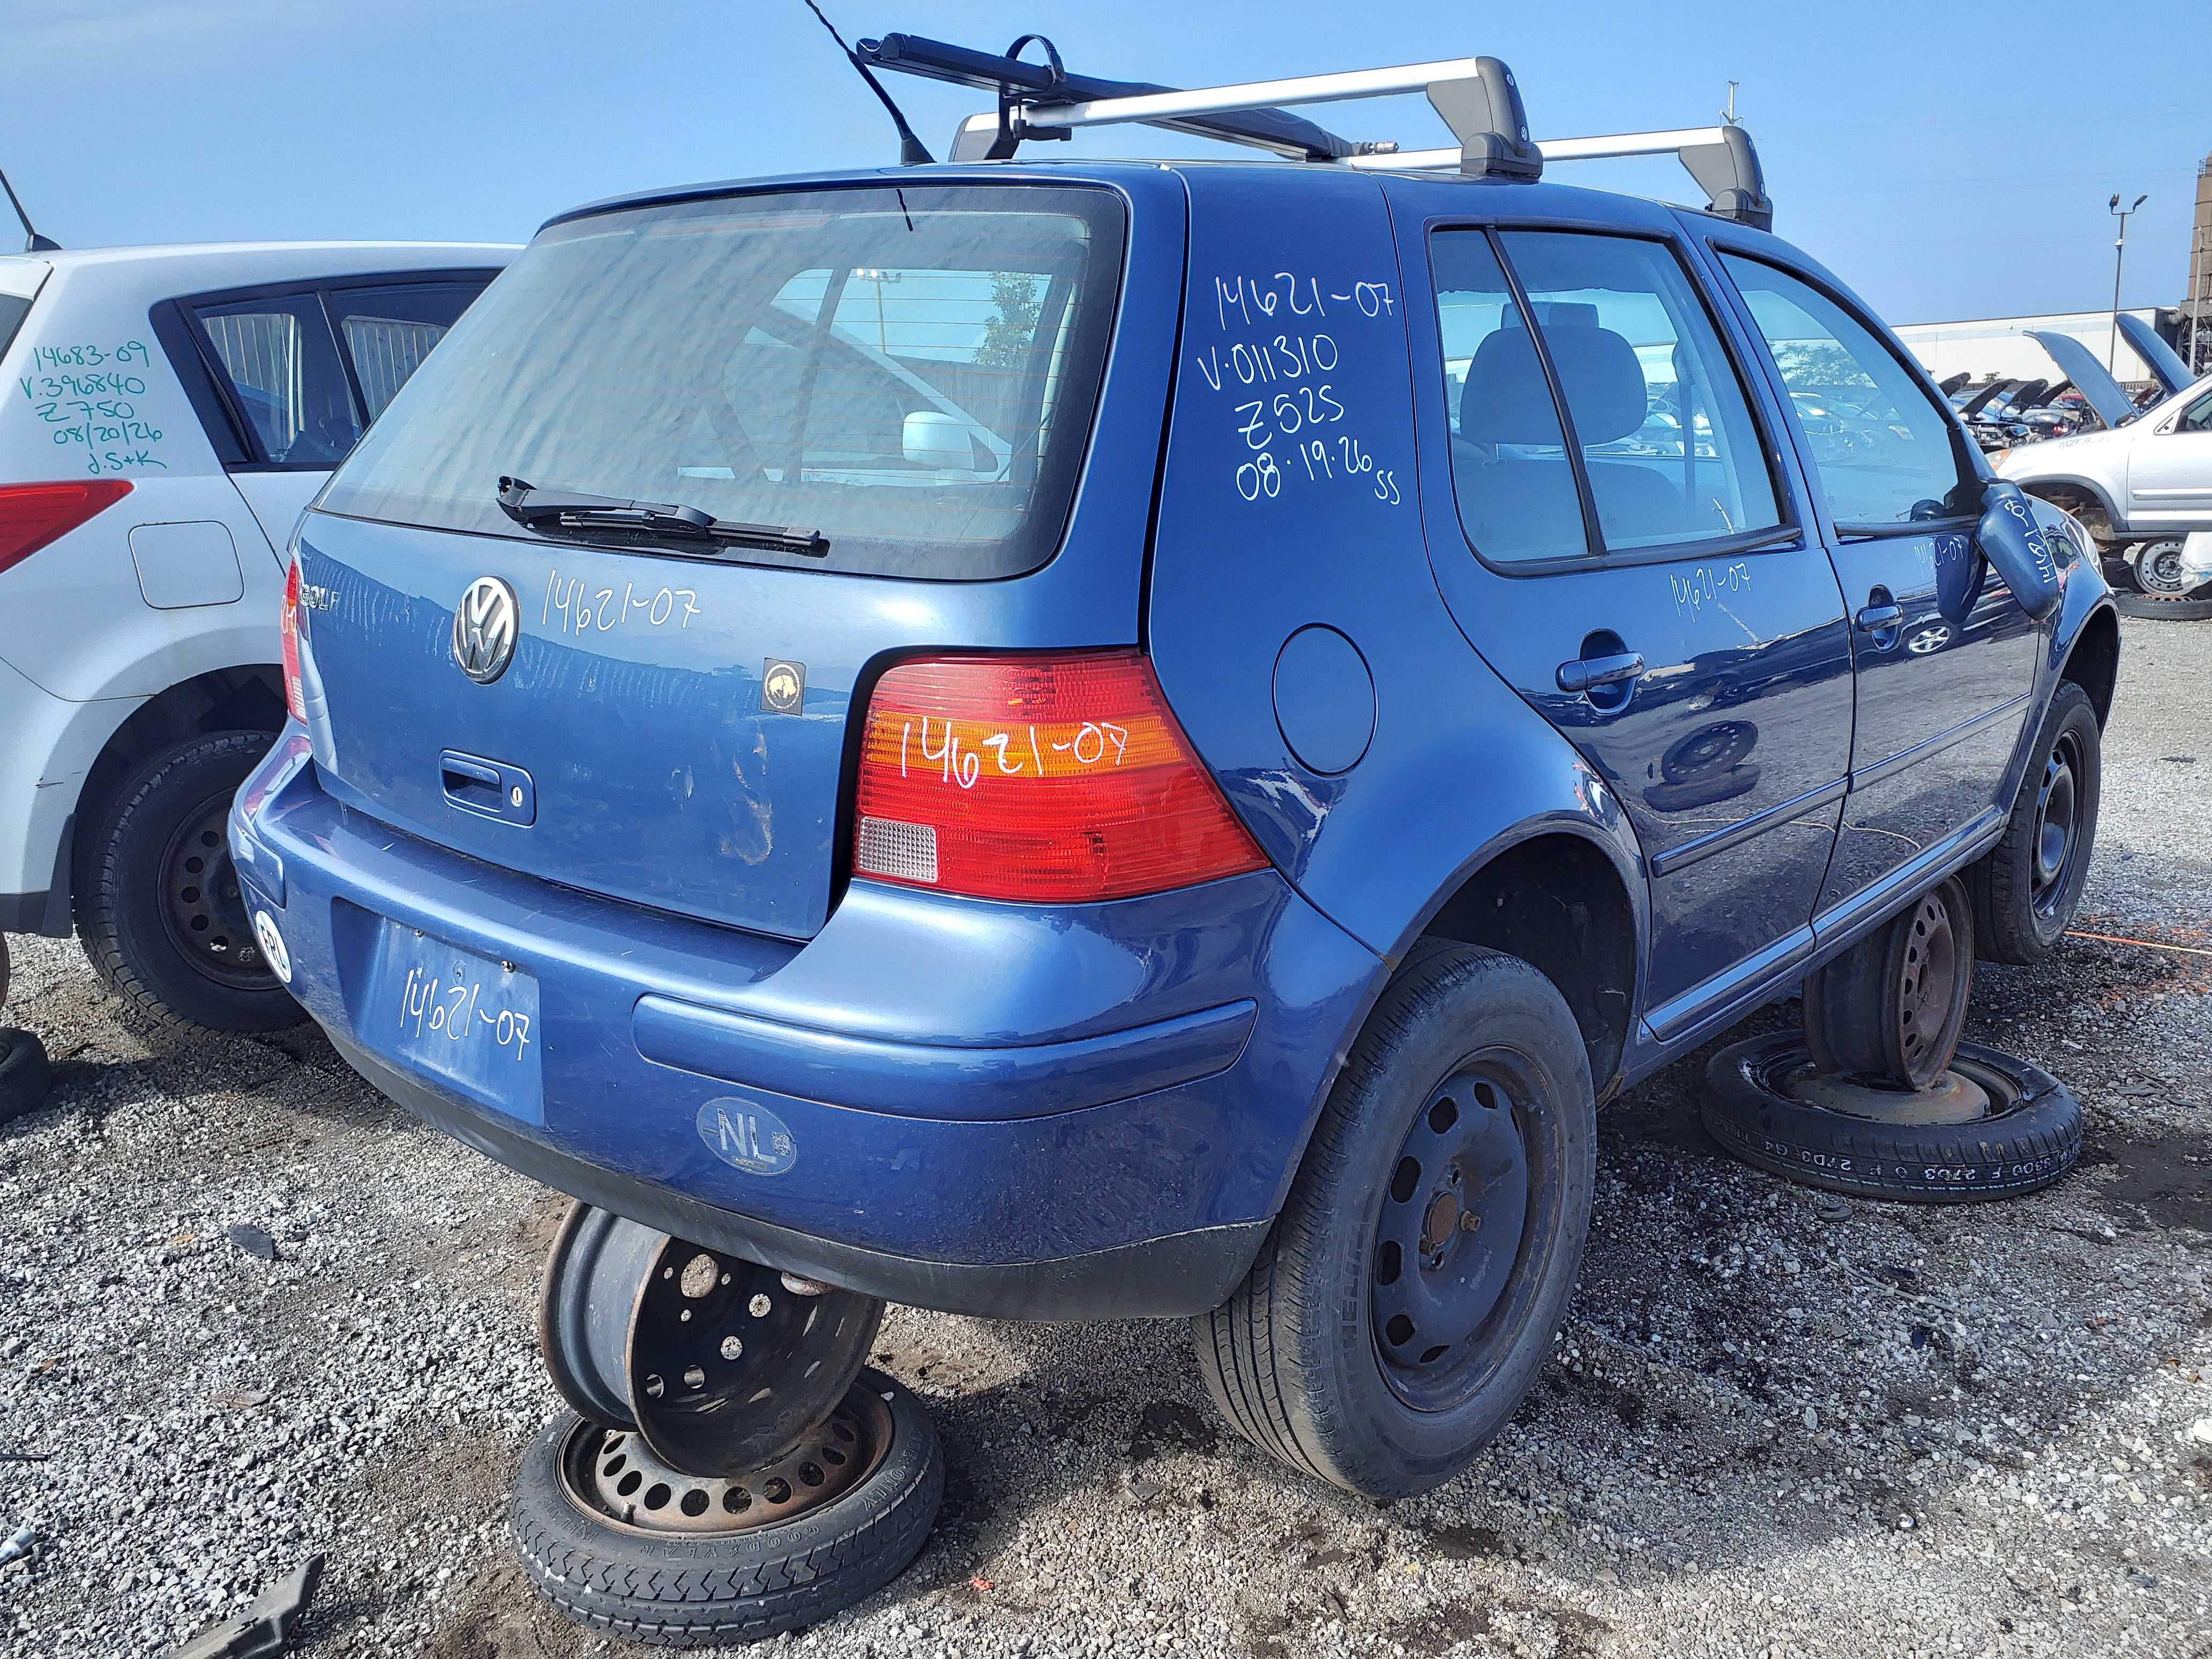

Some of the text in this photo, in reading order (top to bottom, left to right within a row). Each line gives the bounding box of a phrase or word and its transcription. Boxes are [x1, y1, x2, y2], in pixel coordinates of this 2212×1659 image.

[1216, 272, 1394, 330] 14621-07
[34, 341, 150, 372] 14683-09
[54, 421, 162, 449] 08/20/26
[1914, 537, 1963, 579] 14621-07
[2004, 499, 2057, 584] 14621-07
[300, 584, 339, 611] GOLF
[543, 570, 701, 636] 14621-07
[1670, 563, 1751, 623] 14621-07
[454, 576, 519, 684] VW
[901, 716, 1128, 788] 14621-07
[400, 969, 530, 1060] 14621-07
[718, 1108, 777, 1163] NL
[862, 1470, 905, 1511] ONLY
